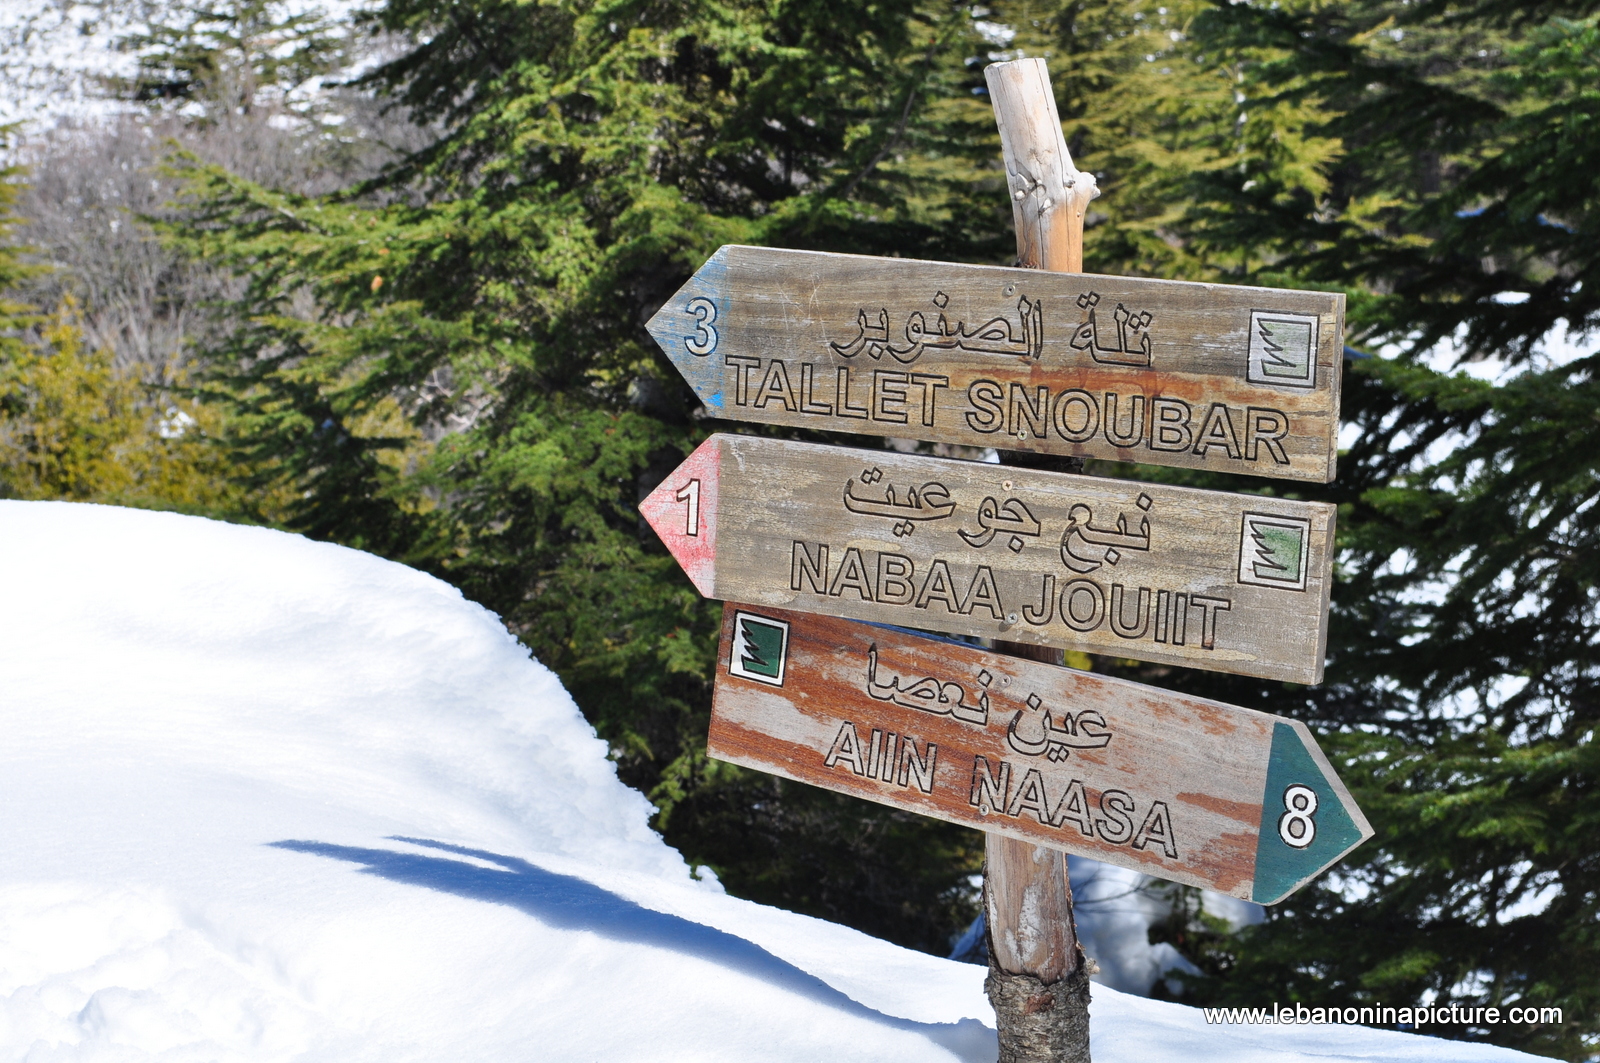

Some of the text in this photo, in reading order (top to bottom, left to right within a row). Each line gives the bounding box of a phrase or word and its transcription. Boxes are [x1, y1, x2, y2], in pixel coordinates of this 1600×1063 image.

[684, 297, 718, 357] 3
[830, 291, 1153, 367] تلة الصنوبر
[725, 355, 1290, 465] TALLET SNOUBAR
[676, 478, 700, 537] 1
[1060, 492, 1153, 574] نبع
[790, 540, 1231, 650] NABAA JOUIIT
[1007, 692, 1113, 763] عين
[824, 721, 1178, 860] AIIN NAASA
[1277, 783, 1319, 850] 8
